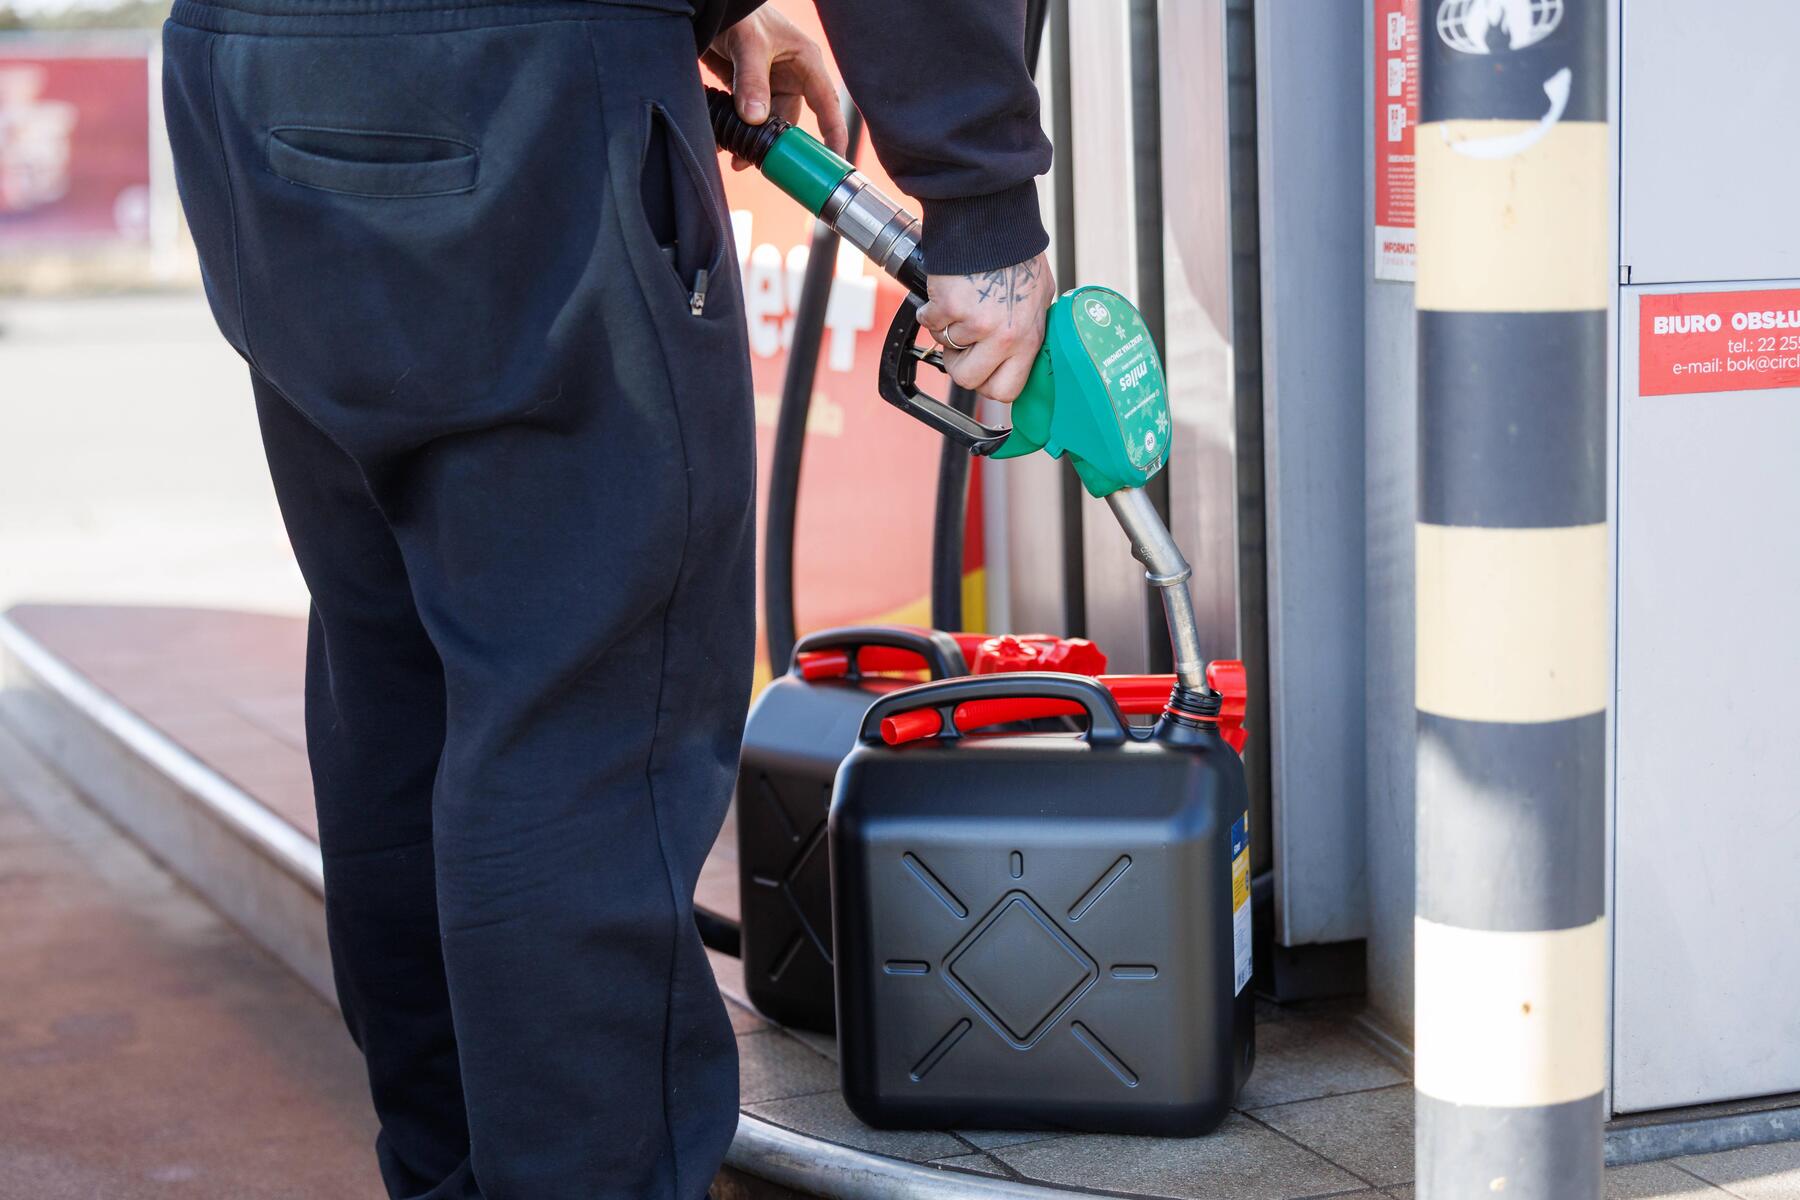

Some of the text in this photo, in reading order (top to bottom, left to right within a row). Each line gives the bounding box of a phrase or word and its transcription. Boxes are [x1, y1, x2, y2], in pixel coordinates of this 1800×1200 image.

[1088, 303, 1108, 321] 95
[1654, 310, 1800, 335] BIURO OBSŁU
[1727, 335, 1800, 353] tel.: 22 25
[1672, 358, 1723, 375] e-mail:
[1119, 361, 1148, 391] miles
